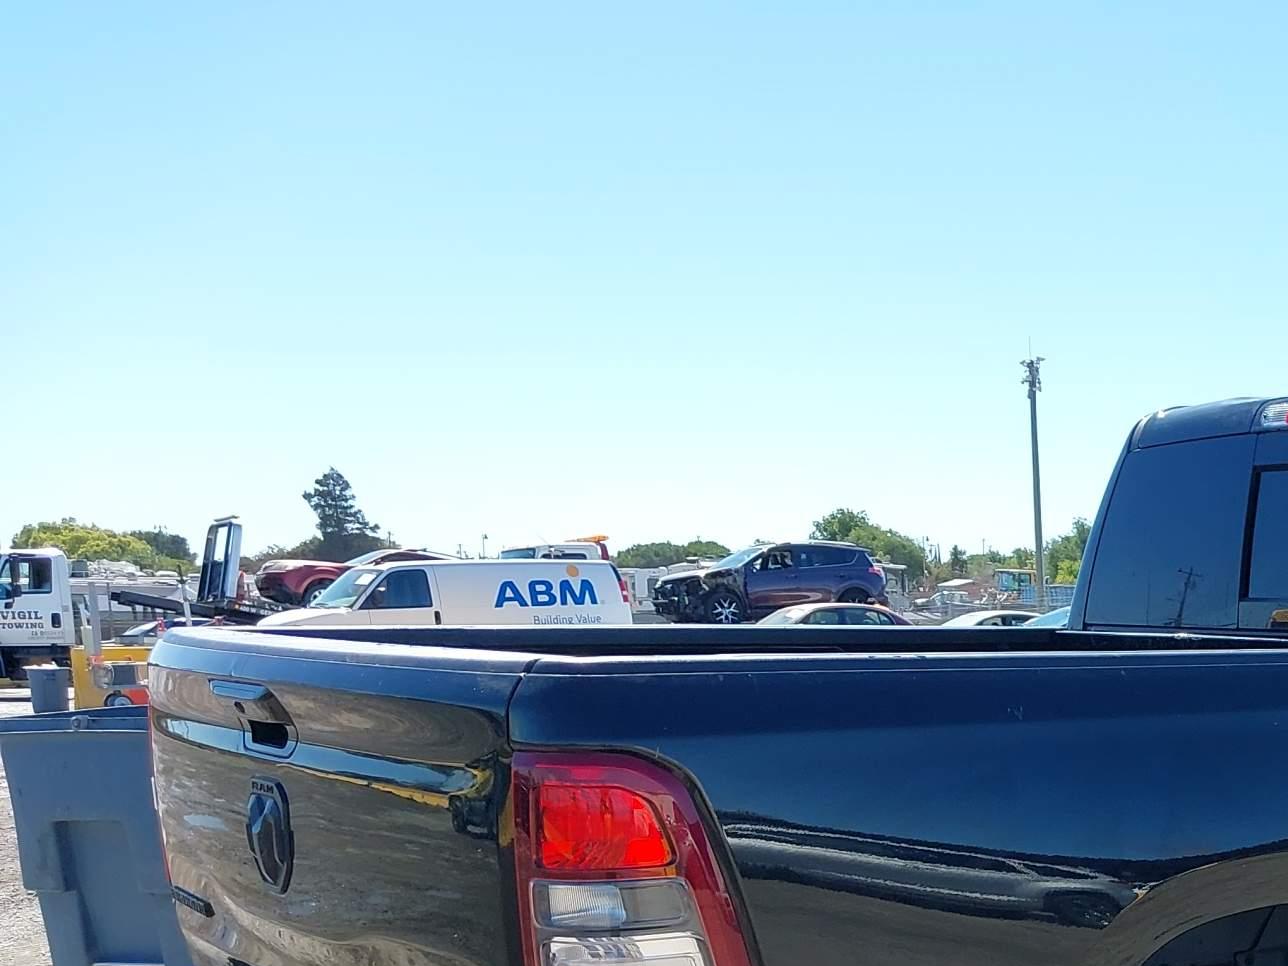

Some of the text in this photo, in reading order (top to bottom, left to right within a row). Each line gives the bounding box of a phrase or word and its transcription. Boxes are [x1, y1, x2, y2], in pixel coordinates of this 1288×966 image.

[495, 579, 599, 608] ABM
[0, 610, 43, 620] VIGIL
[533, 614, 602, 625] Building Value
[0, 622, 44, 630] TOWING
[251, 780, 274, 794] RAM
